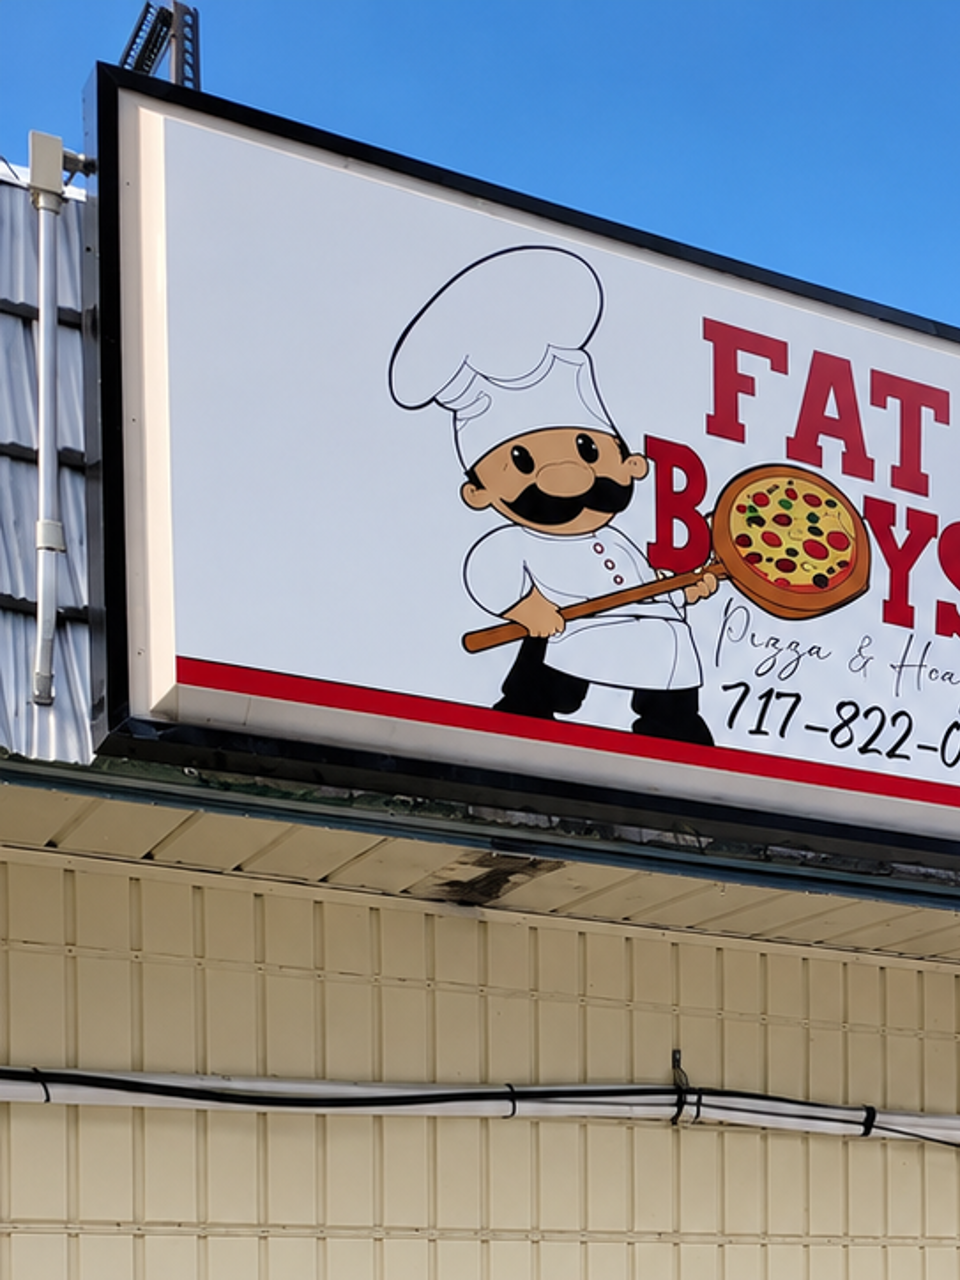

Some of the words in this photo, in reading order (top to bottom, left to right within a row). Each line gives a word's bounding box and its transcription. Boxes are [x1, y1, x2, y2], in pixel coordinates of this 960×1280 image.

[703, 317, 950, 497] FAT
[715, 597, 832, 681] Pizza
[848, 635, 875, 678] &
